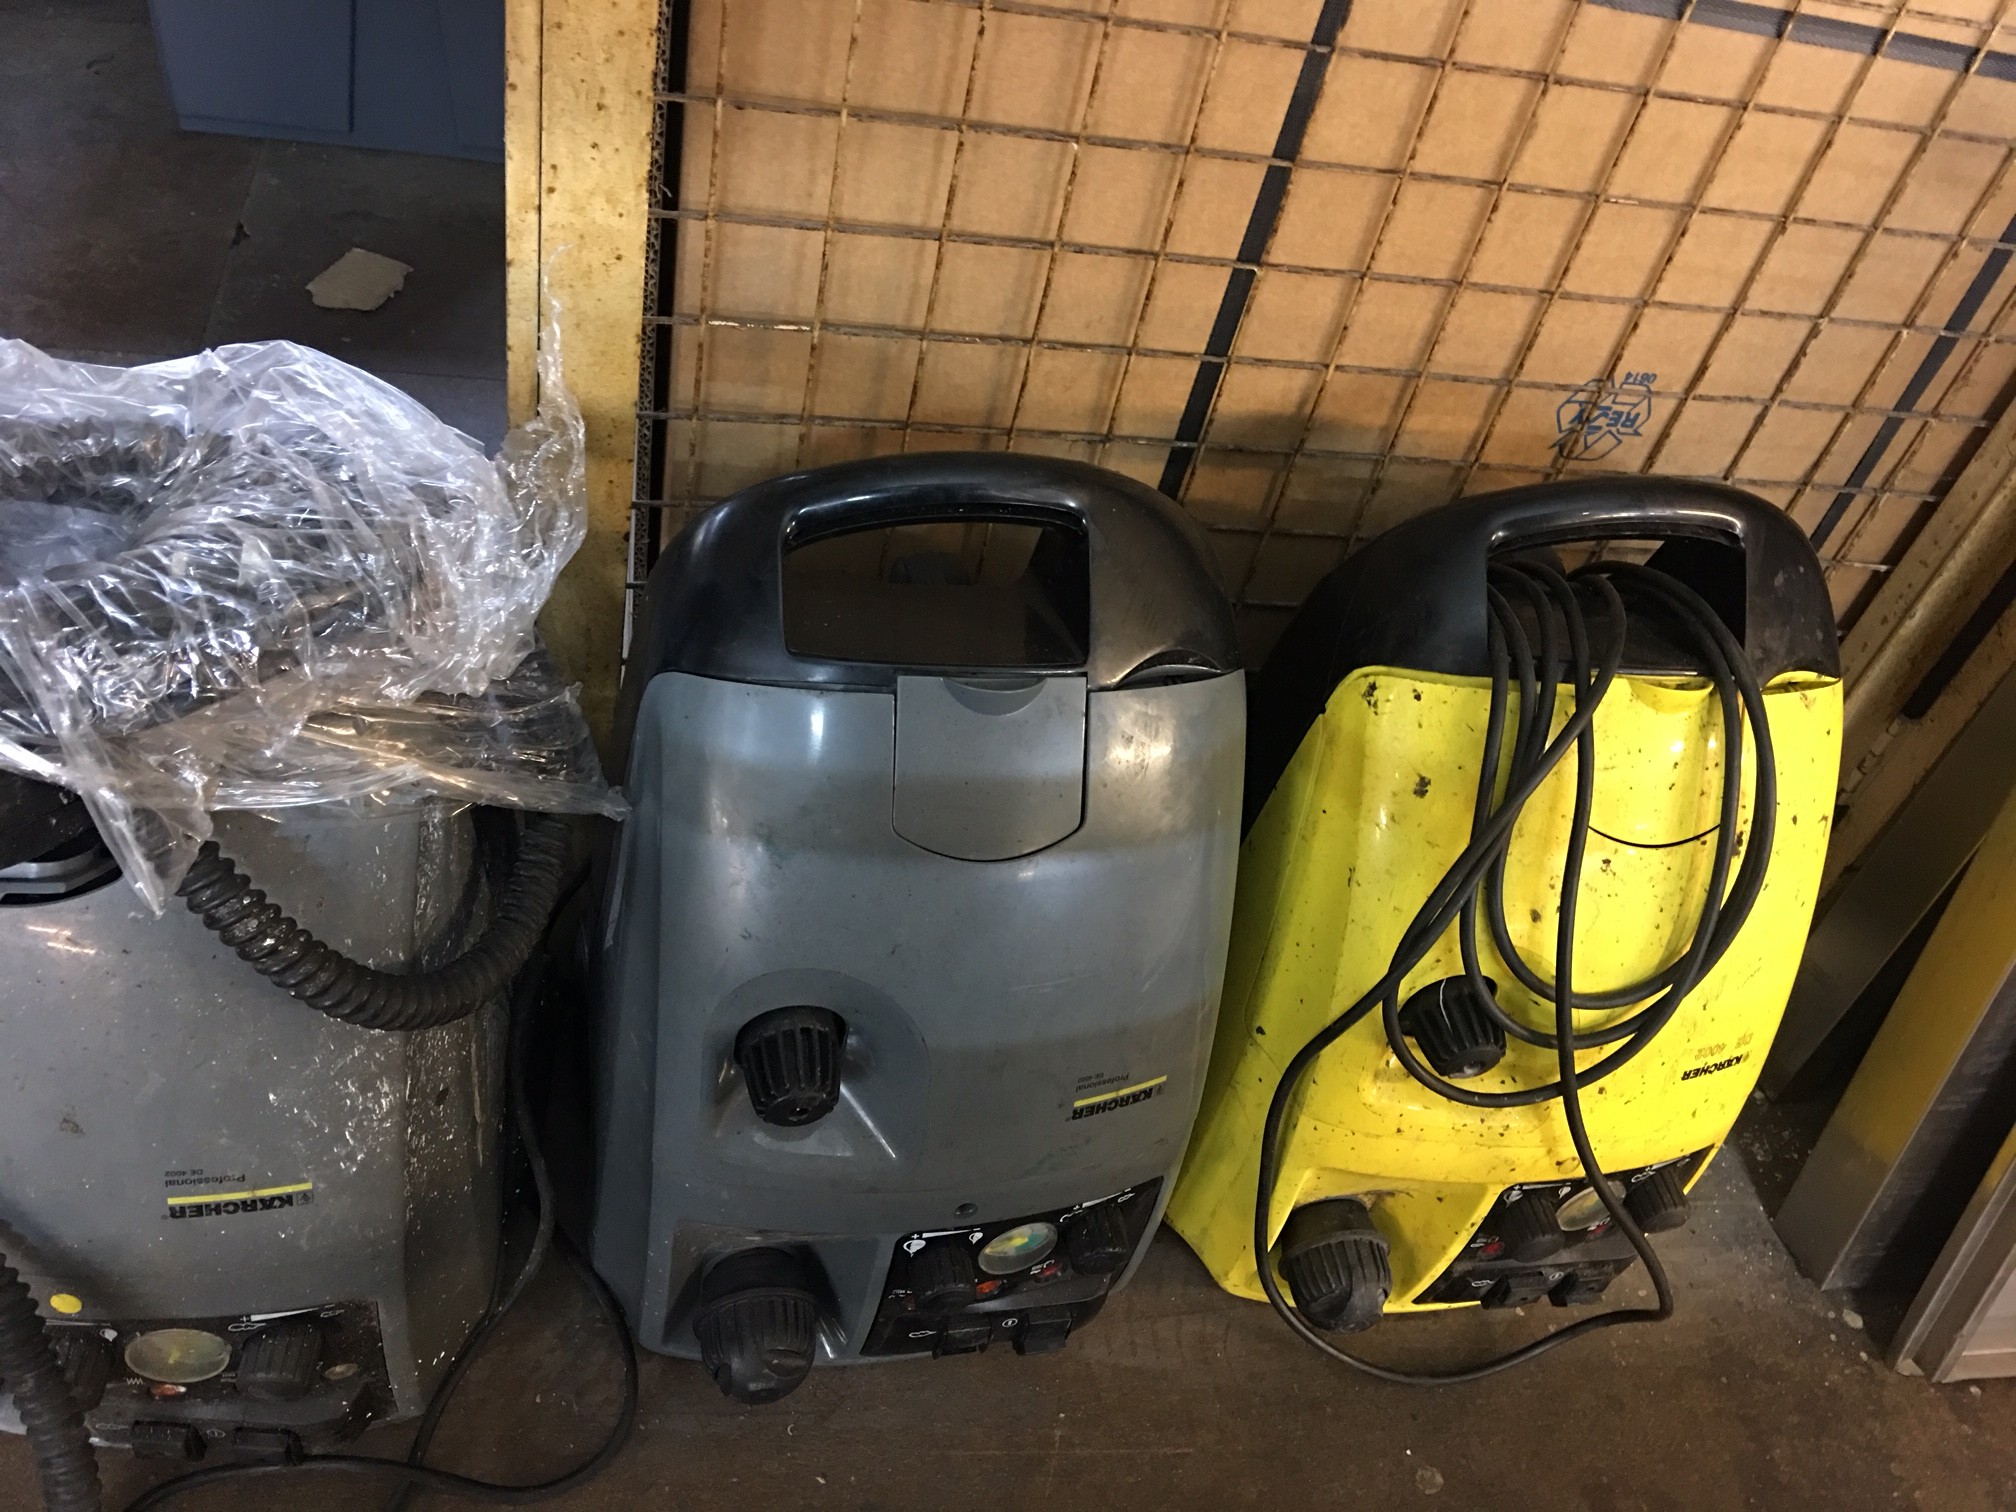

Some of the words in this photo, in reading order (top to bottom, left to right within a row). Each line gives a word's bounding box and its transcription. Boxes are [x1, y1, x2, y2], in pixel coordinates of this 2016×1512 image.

[1075, 1071, 1130, 1093] Professional
[164, 1173, 247, 1188] Professional
[168, 1194, 294, 1219] KÄRCHER
